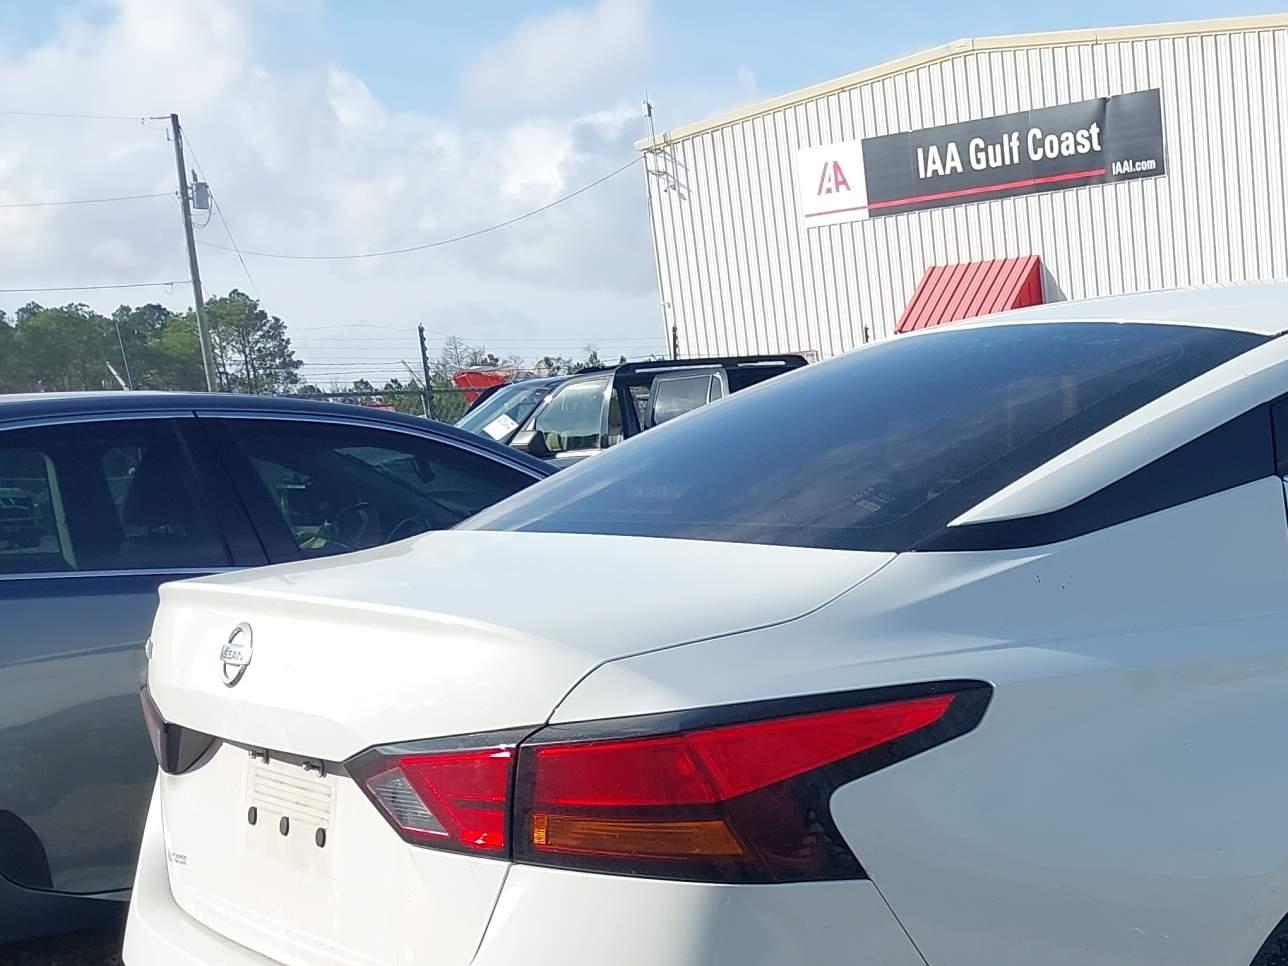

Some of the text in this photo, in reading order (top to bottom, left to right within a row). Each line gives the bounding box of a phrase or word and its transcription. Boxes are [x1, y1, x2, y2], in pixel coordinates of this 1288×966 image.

[917, 122, 1102, 179] IAA Gulf Coast
[1111, 158, 1156, 176] IAAI.com
